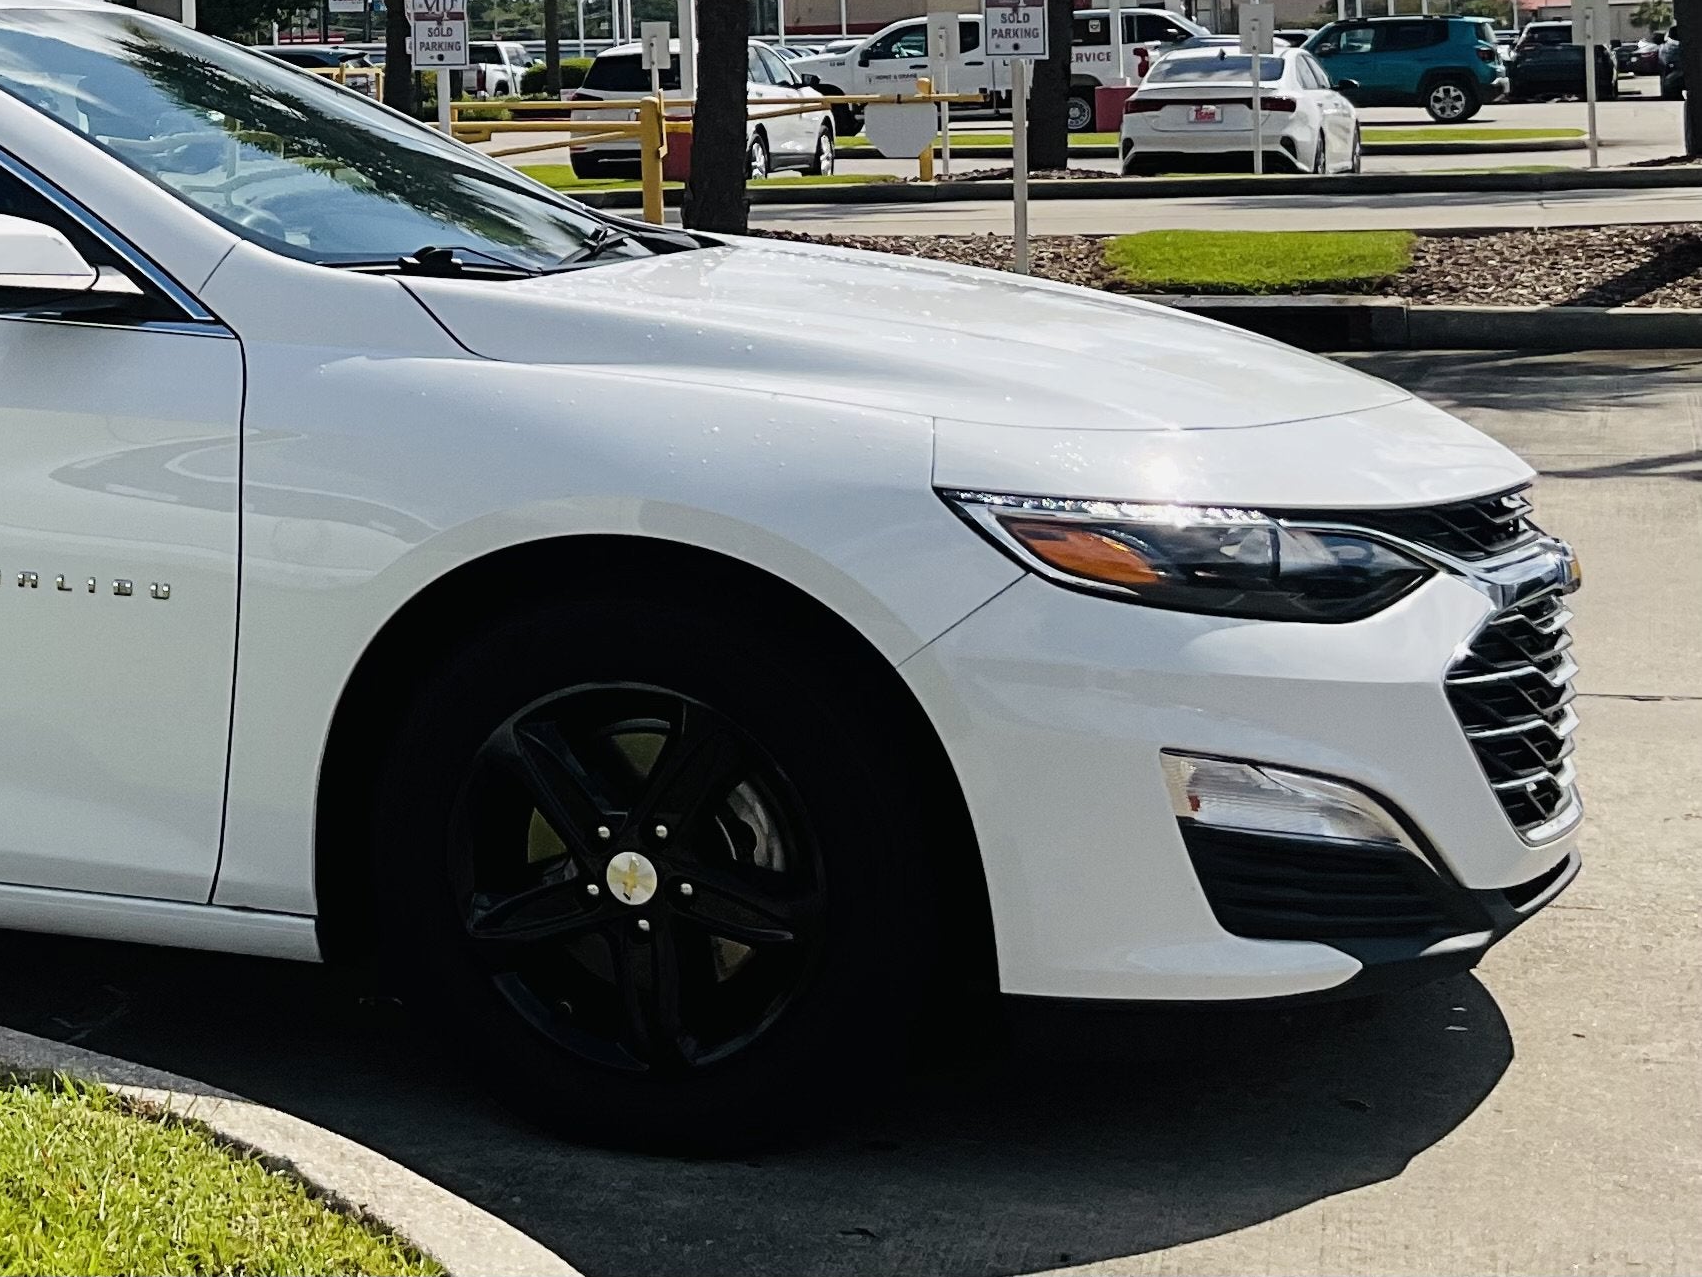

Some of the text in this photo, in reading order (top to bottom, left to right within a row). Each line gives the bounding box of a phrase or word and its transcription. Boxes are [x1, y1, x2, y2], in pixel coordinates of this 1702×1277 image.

[1000, 13, 1030, 24] SOLD
[427, 27, 453, 37] SOLD
[991, 28, 1040, 39] PARKING
[419, 41, 462, 51] PARKING
